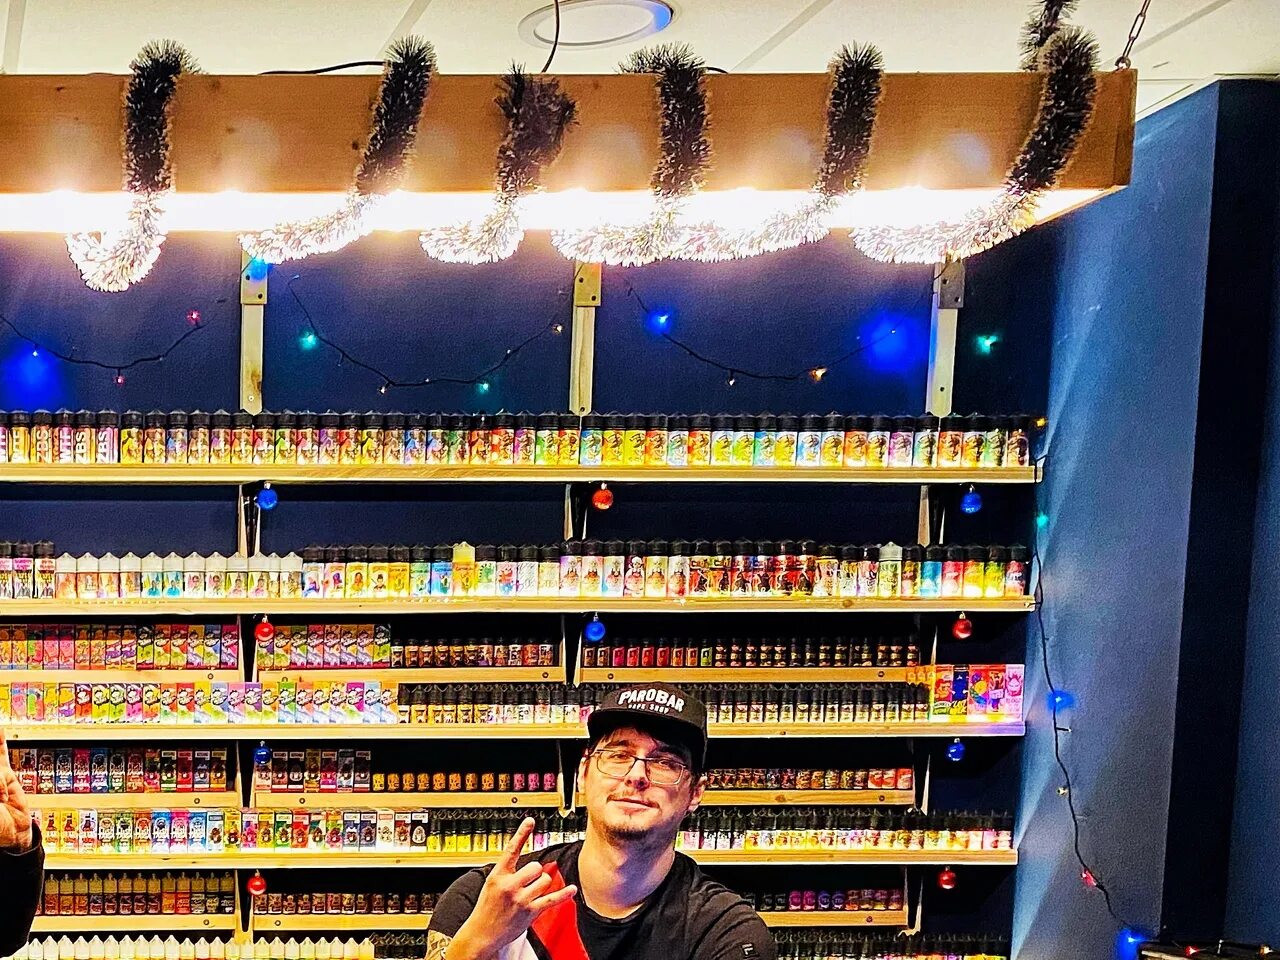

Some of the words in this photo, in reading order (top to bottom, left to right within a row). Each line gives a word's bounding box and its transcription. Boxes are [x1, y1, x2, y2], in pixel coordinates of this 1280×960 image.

[36, 430, 49, 463] ZBS
[75, 431, 87, 463] ZBS
[97, 431, 107, 463] ZBS
[617, 688, 685, 713] PAROBAR
